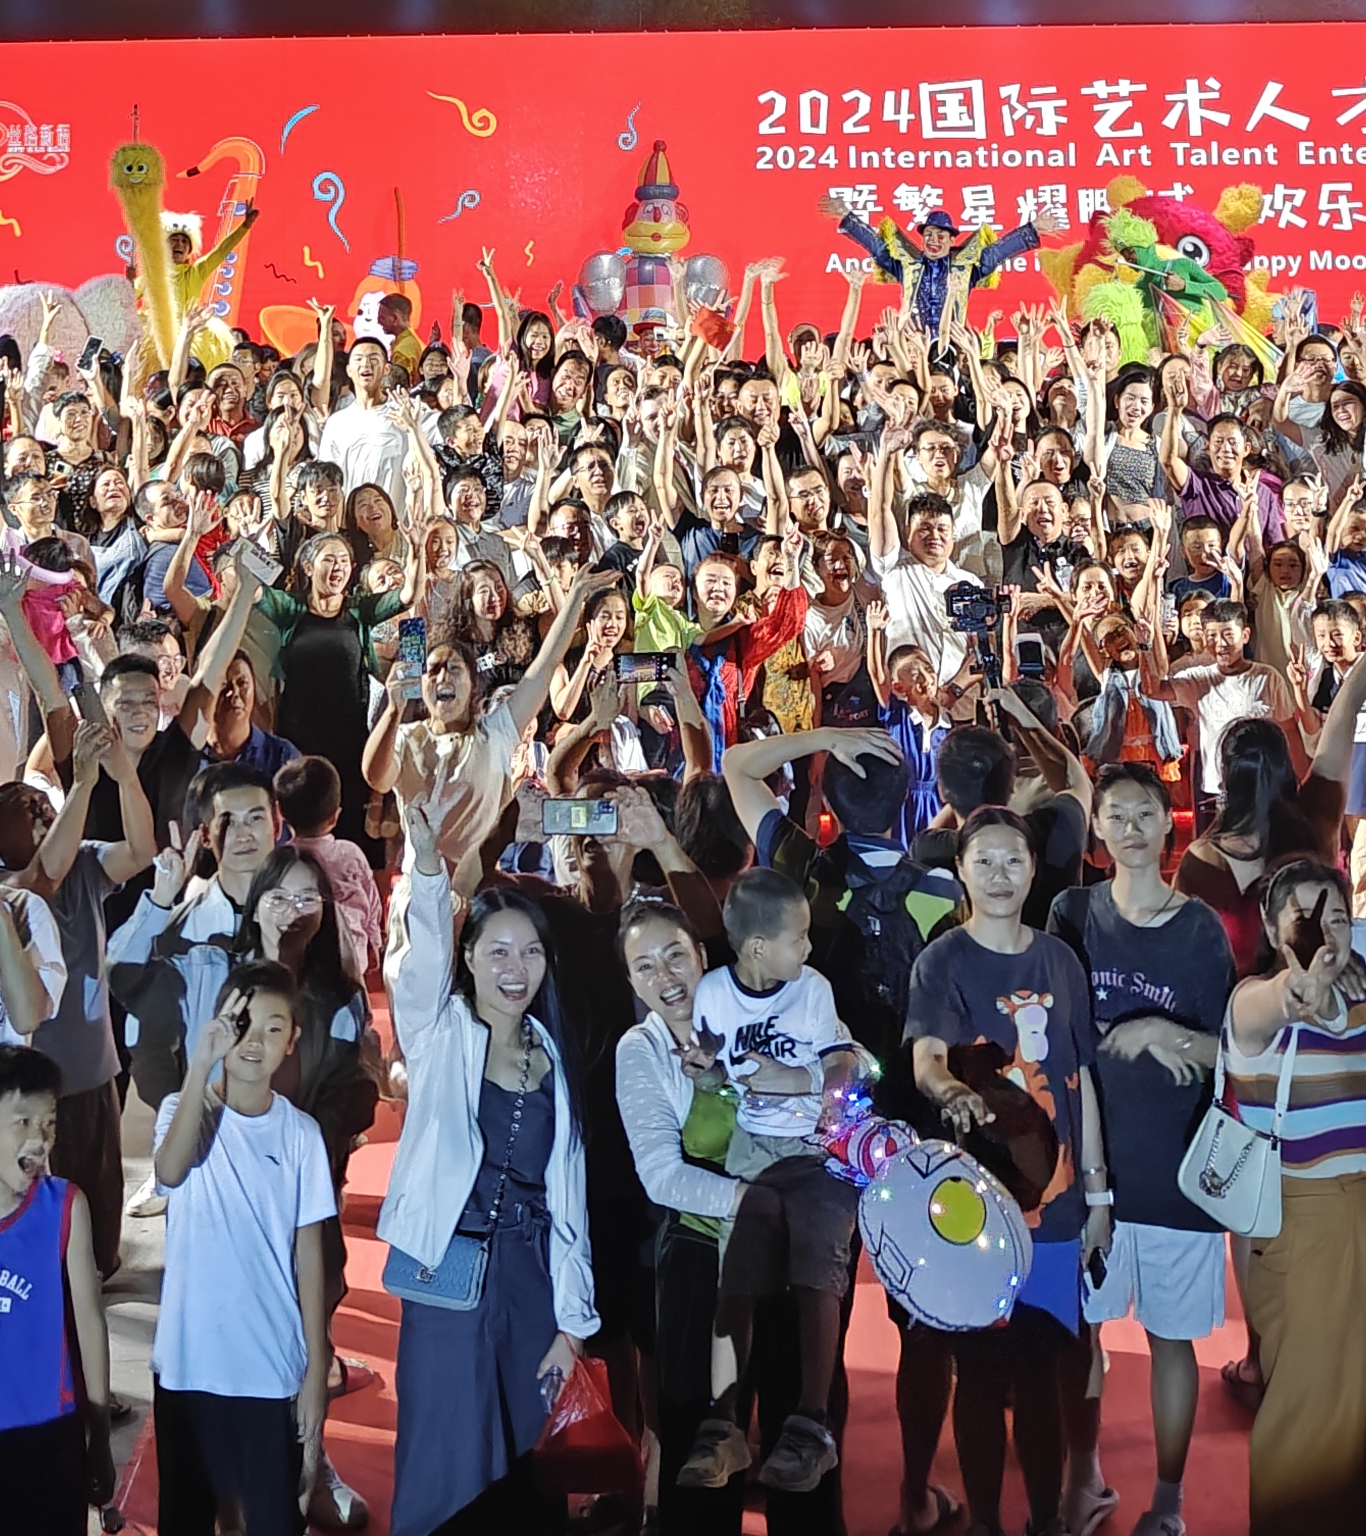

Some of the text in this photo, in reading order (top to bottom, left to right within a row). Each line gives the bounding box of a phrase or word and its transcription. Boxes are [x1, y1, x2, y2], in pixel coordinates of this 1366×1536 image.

[755, 145, 839, 170] 2024
[848, 142, 1077, 169] International
[1095, 142, 1152, 167] Art
[1170, 141, 1279, 167] Talent
